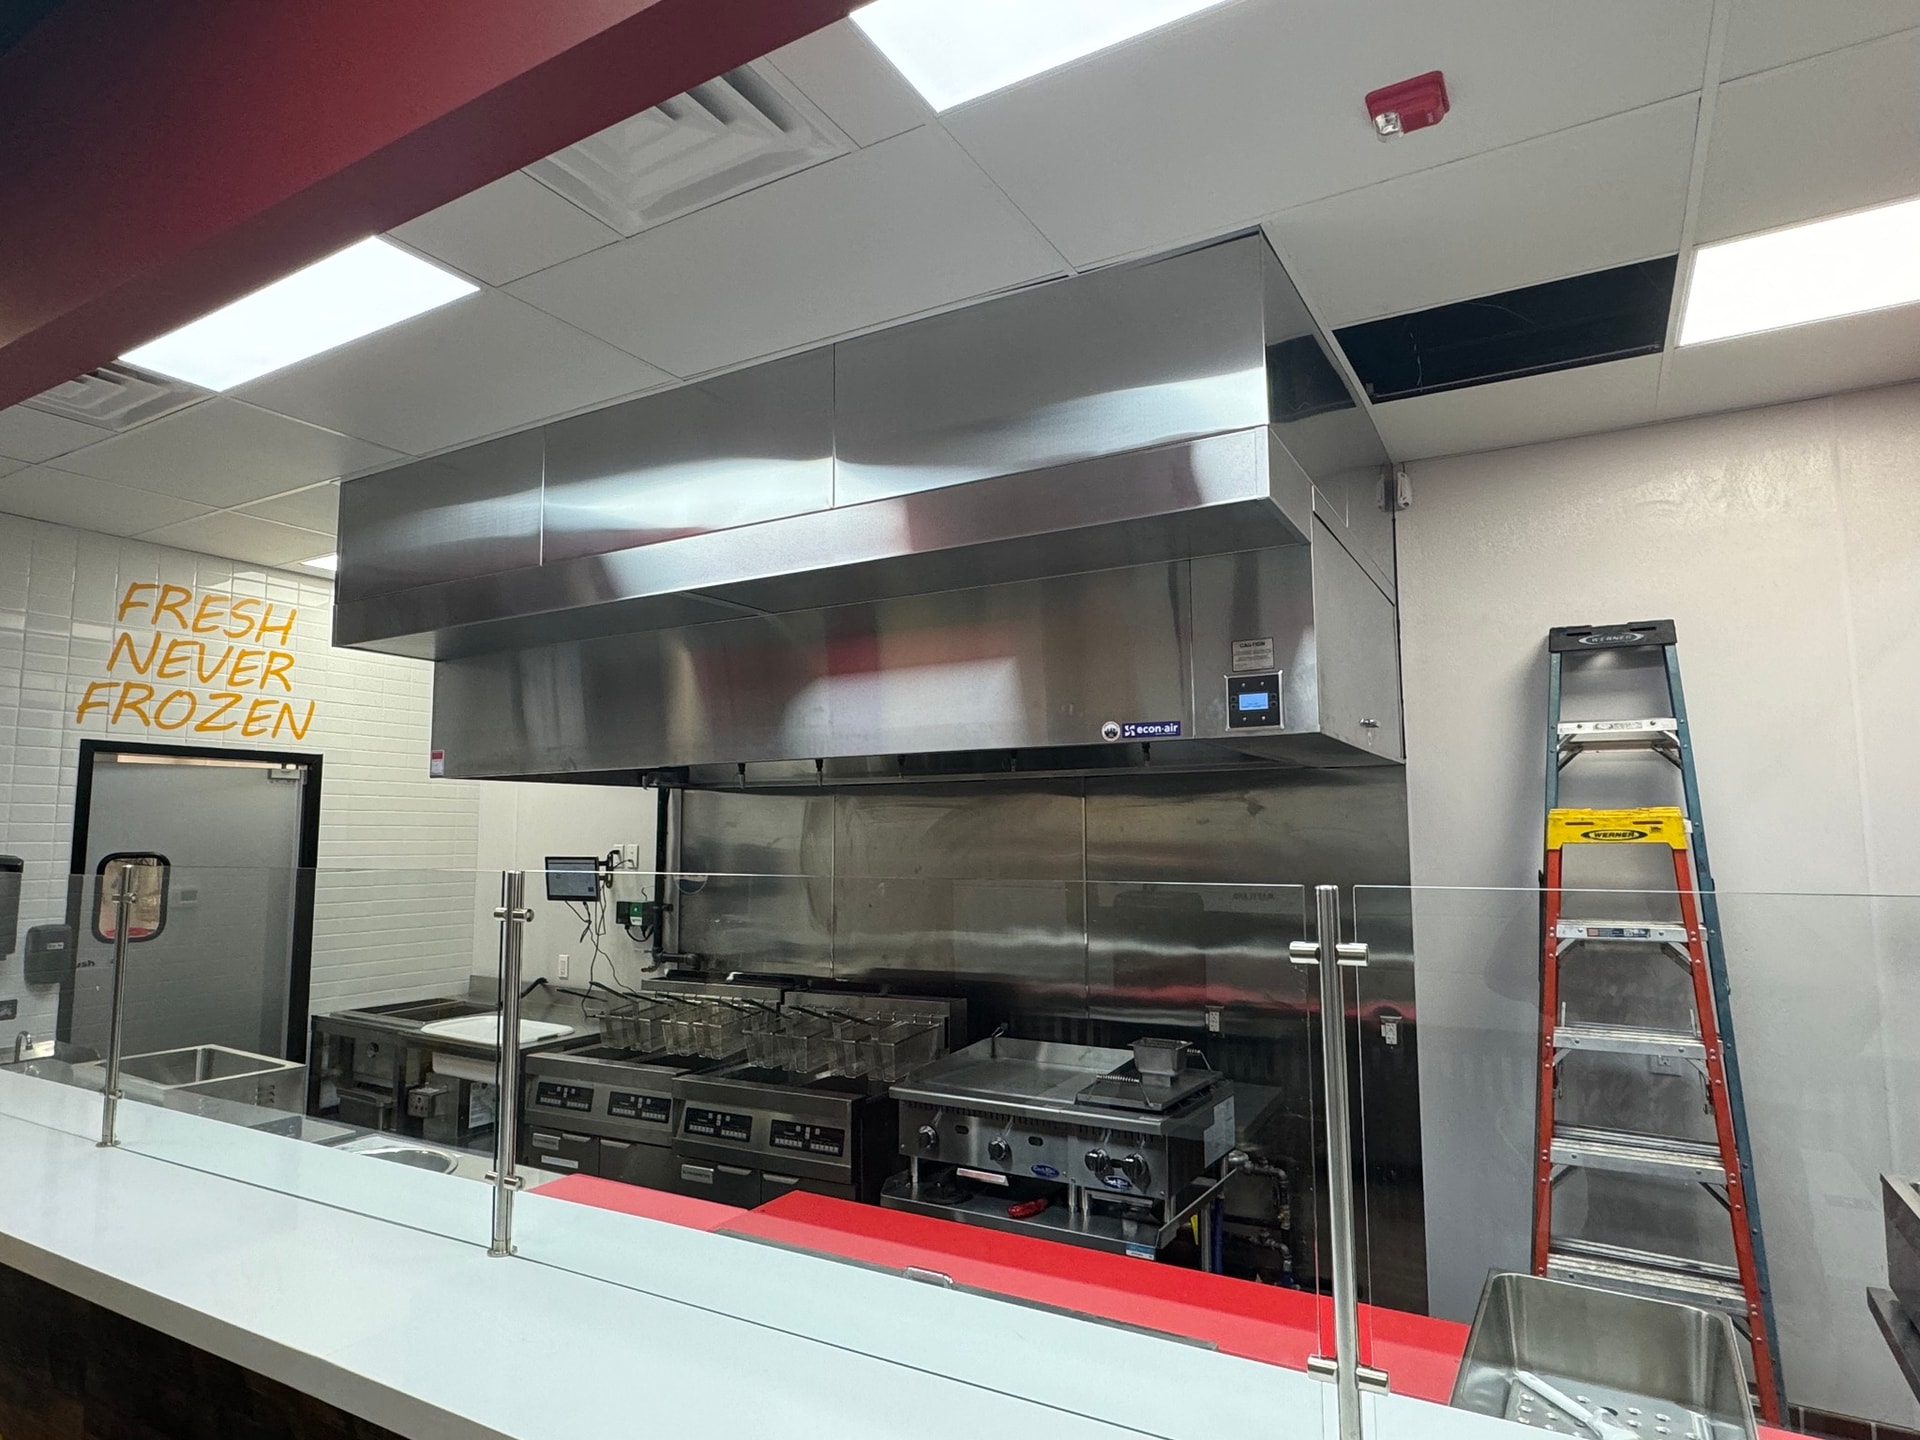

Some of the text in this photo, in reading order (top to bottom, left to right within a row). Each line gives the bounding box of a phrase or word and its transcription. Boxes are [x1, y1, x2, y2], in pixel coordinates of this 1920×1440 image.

[118, 582, 297, 646] FRESH
[106, 630, 296, 692] NEVER
[76, 681, 316, 740] FROZEN
